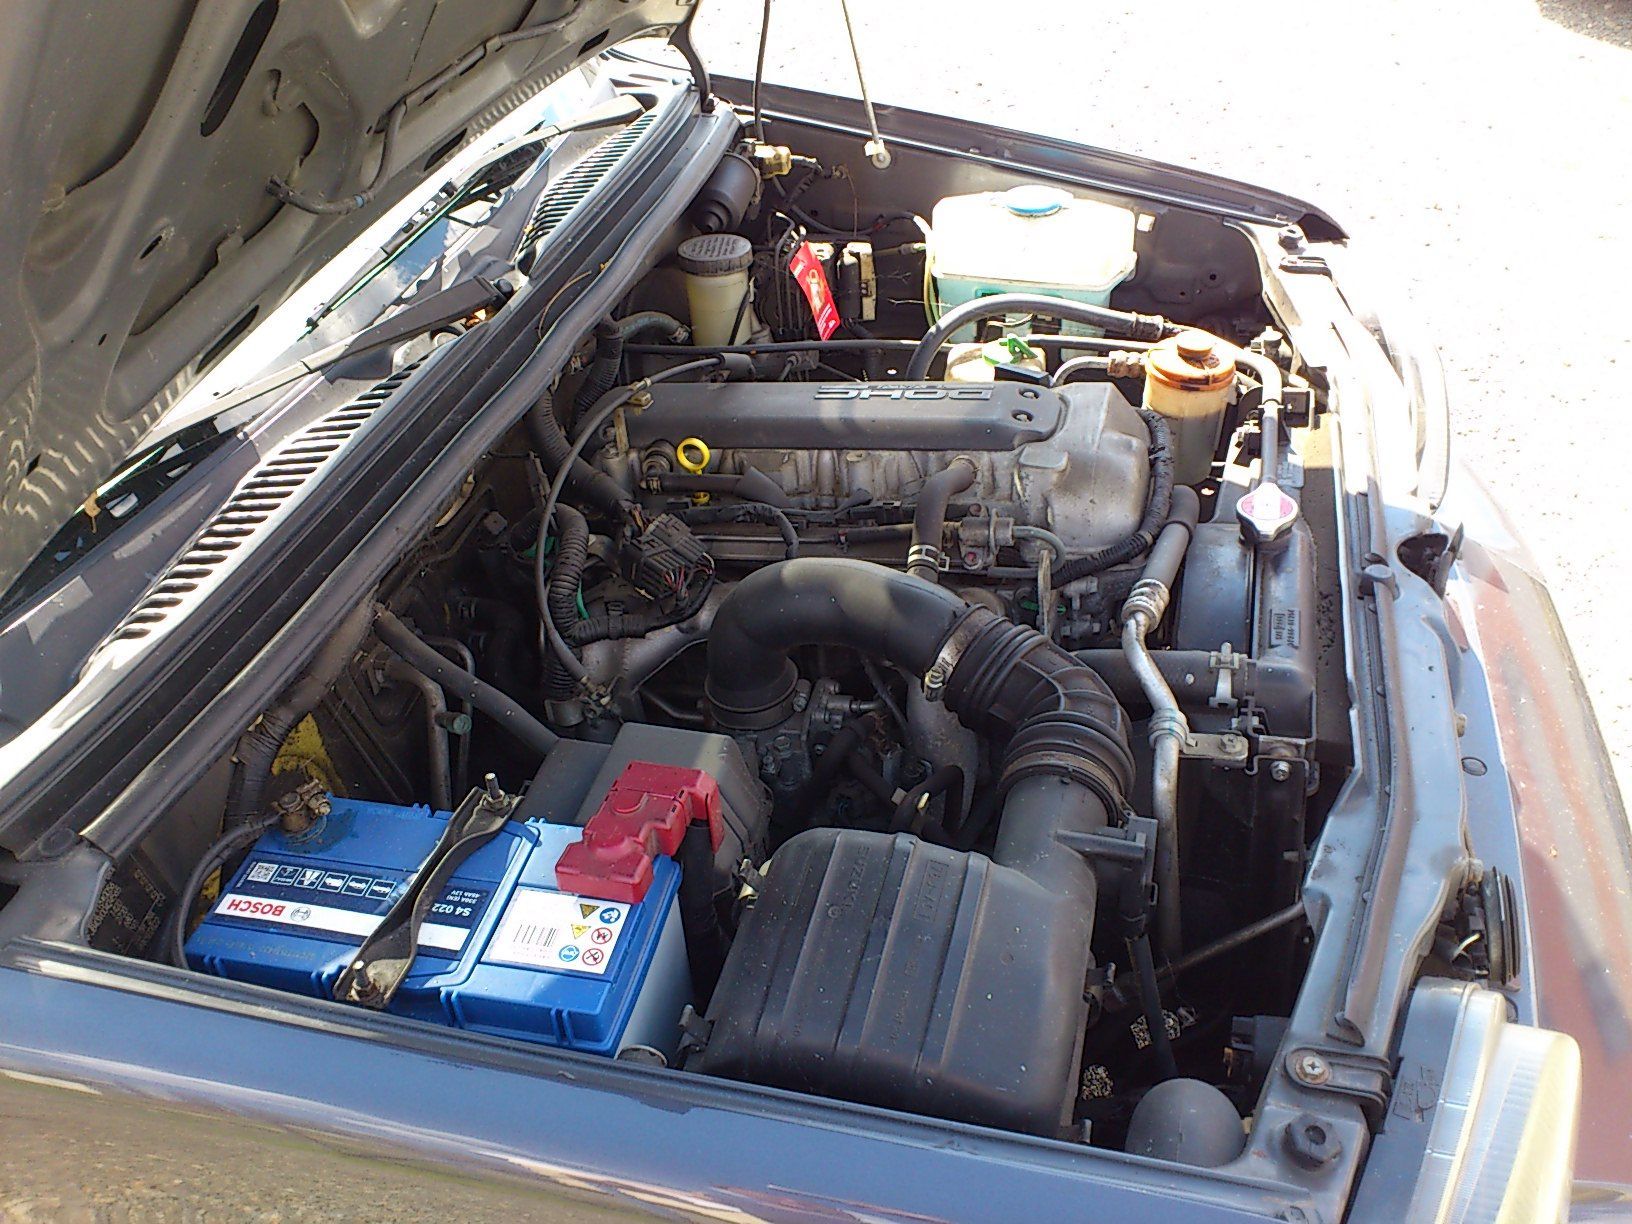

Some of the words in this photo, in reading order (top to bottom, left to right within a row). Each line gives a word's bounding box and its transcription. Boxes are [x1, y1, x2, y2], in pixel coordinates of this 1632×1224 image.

[814, 383, 995, 400] DOHC
[226, 899, 286, 917] BOSCH
[431, 902, 454, 914] 022
[455, 906, 472, 917] S4
